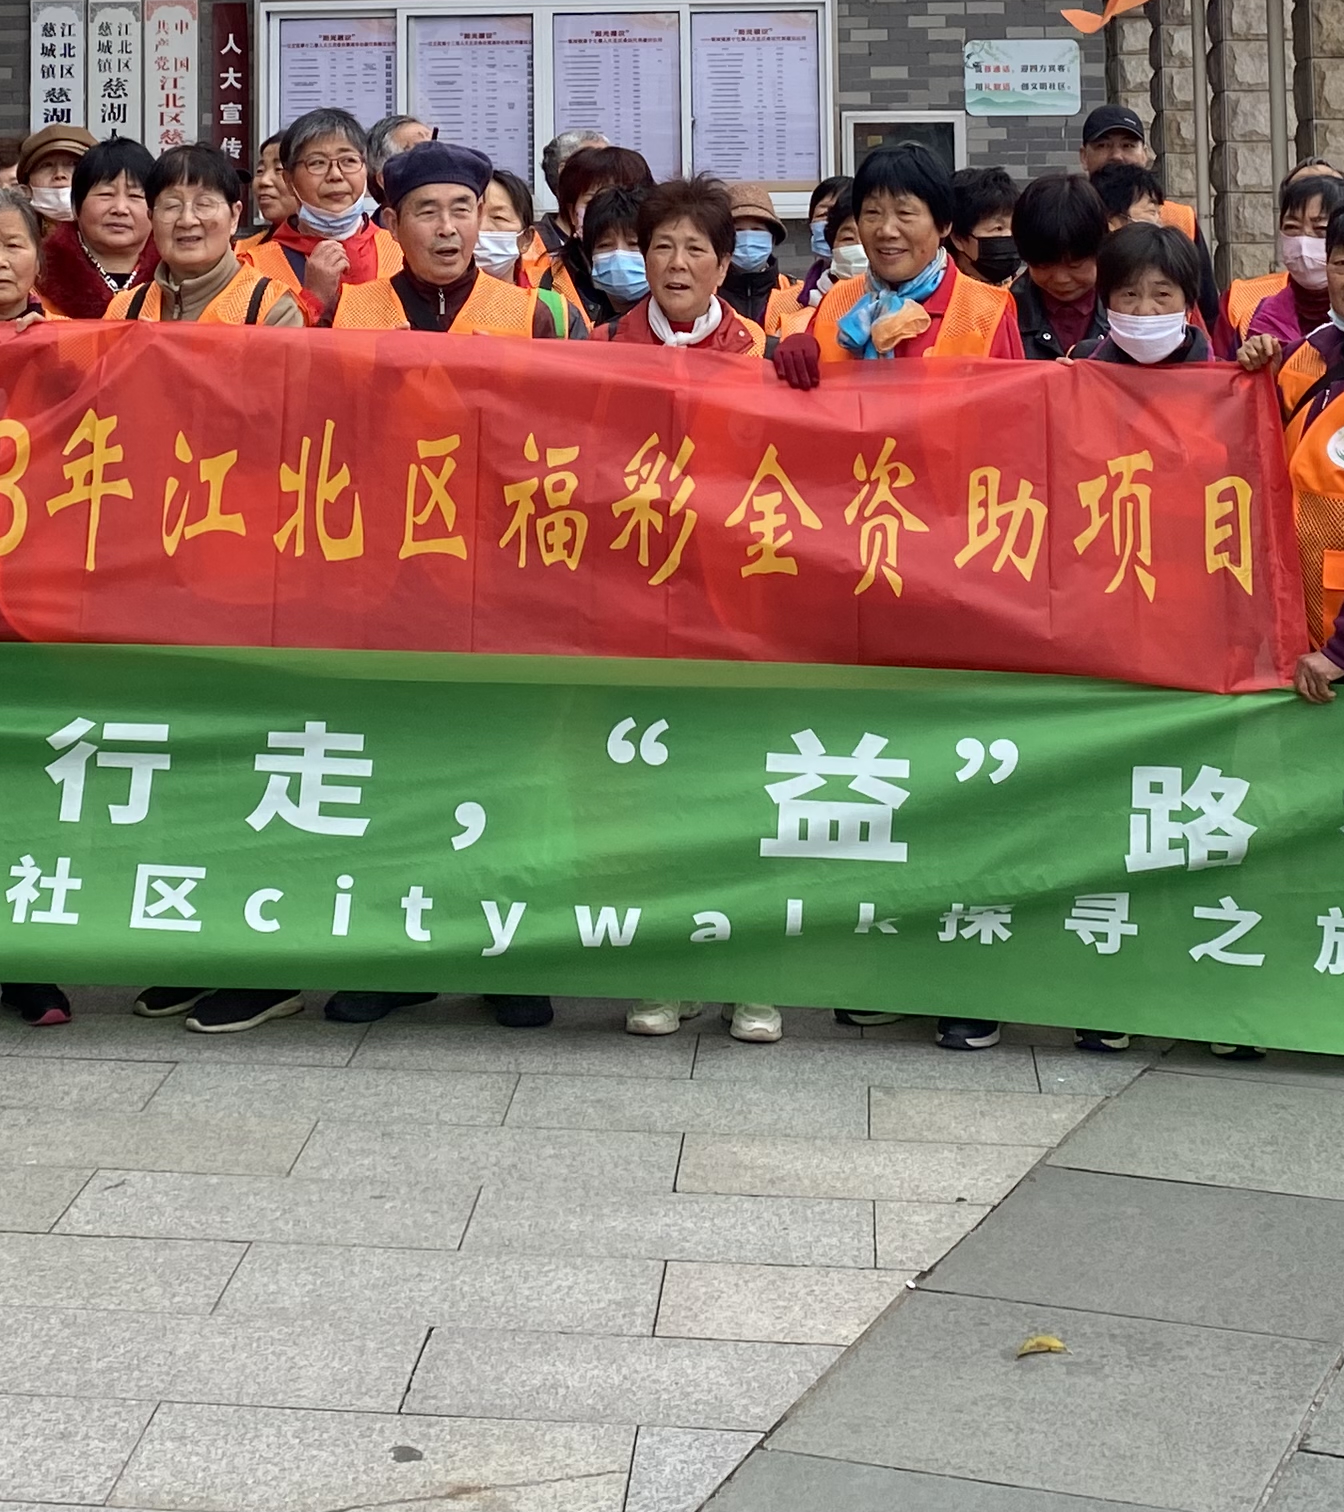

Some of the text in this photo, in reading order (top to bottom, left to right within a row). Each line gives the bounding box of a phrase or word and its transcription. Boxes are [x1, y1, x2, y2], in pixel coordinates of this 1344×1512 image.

[40, 22, 57, 79] 慈城镇
[60, 22, 77, 79] 江北区
[97, 21, 113, 73] 慈城镇
[117, 22, 133, 73] 江北区
[154, 19, 171, 72] 共产党
[43, 87, 72, 124] 慈湖
[158, 75, 186, 153] 江北区慈
[219, 33, 243, 160] 人大宣传
